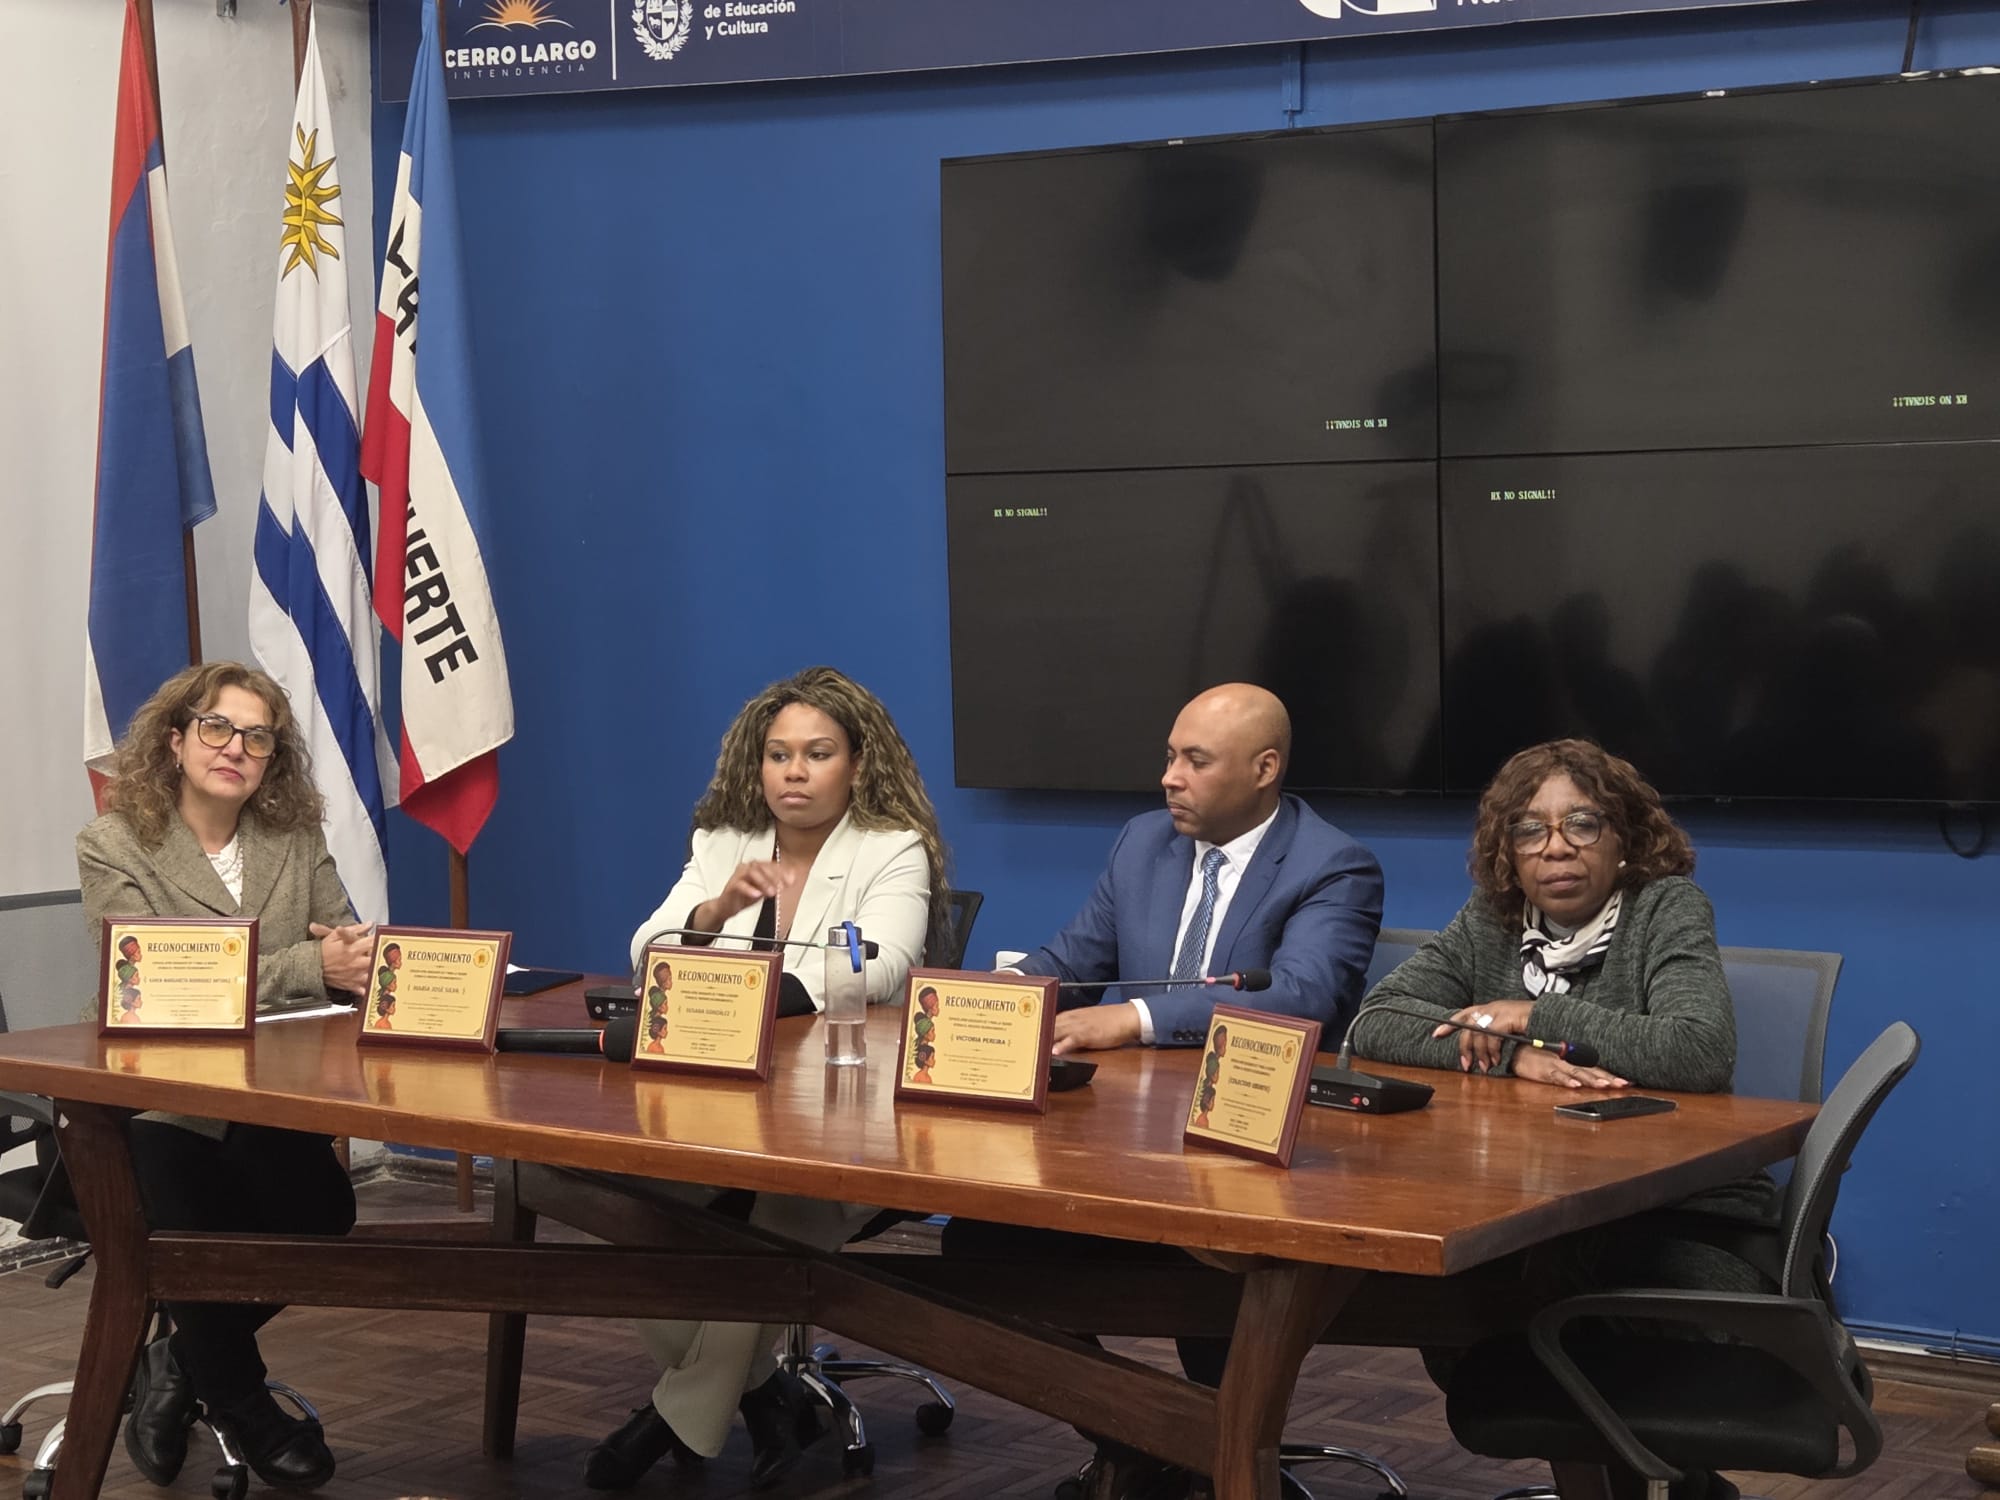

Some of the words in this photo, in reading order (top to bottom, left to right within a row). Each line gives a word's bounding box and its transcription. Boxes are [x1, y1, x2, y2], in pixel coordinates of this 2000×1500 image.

[703, 4, 721, 18] de
[725, 0, 796, 17] Educación
[704, 25, 714, 41] y
[717, 20, 768, 36] Cultura
[445, 46, 516, 68] CERRO
[521, 40, 596, 63] LARGO
[454, 63, 585, 79] INTENDENCIA
[1939, 395, 1952, 405] NO
[1363, 418, 1374, 428] NO
[1504, 491, 1515, 500] NO
[1518, 489, 1556, 500] SIGNAL!!
[1005, 508, 1014, 516] NO
[147, 942, 221, 952] RECONOCIMIENTO
[407, 950, 472, 964] RECONOCIMIENTO
[678, 970, 743, 985] RECONOCIMIENTO
[945, 995, 1016, 1013] RECONOCIMIENTO
[956, 1035, 981, 1043] VICTORIA
[1230, 1035, 1282, 1056] RECONOCIMIENTO
